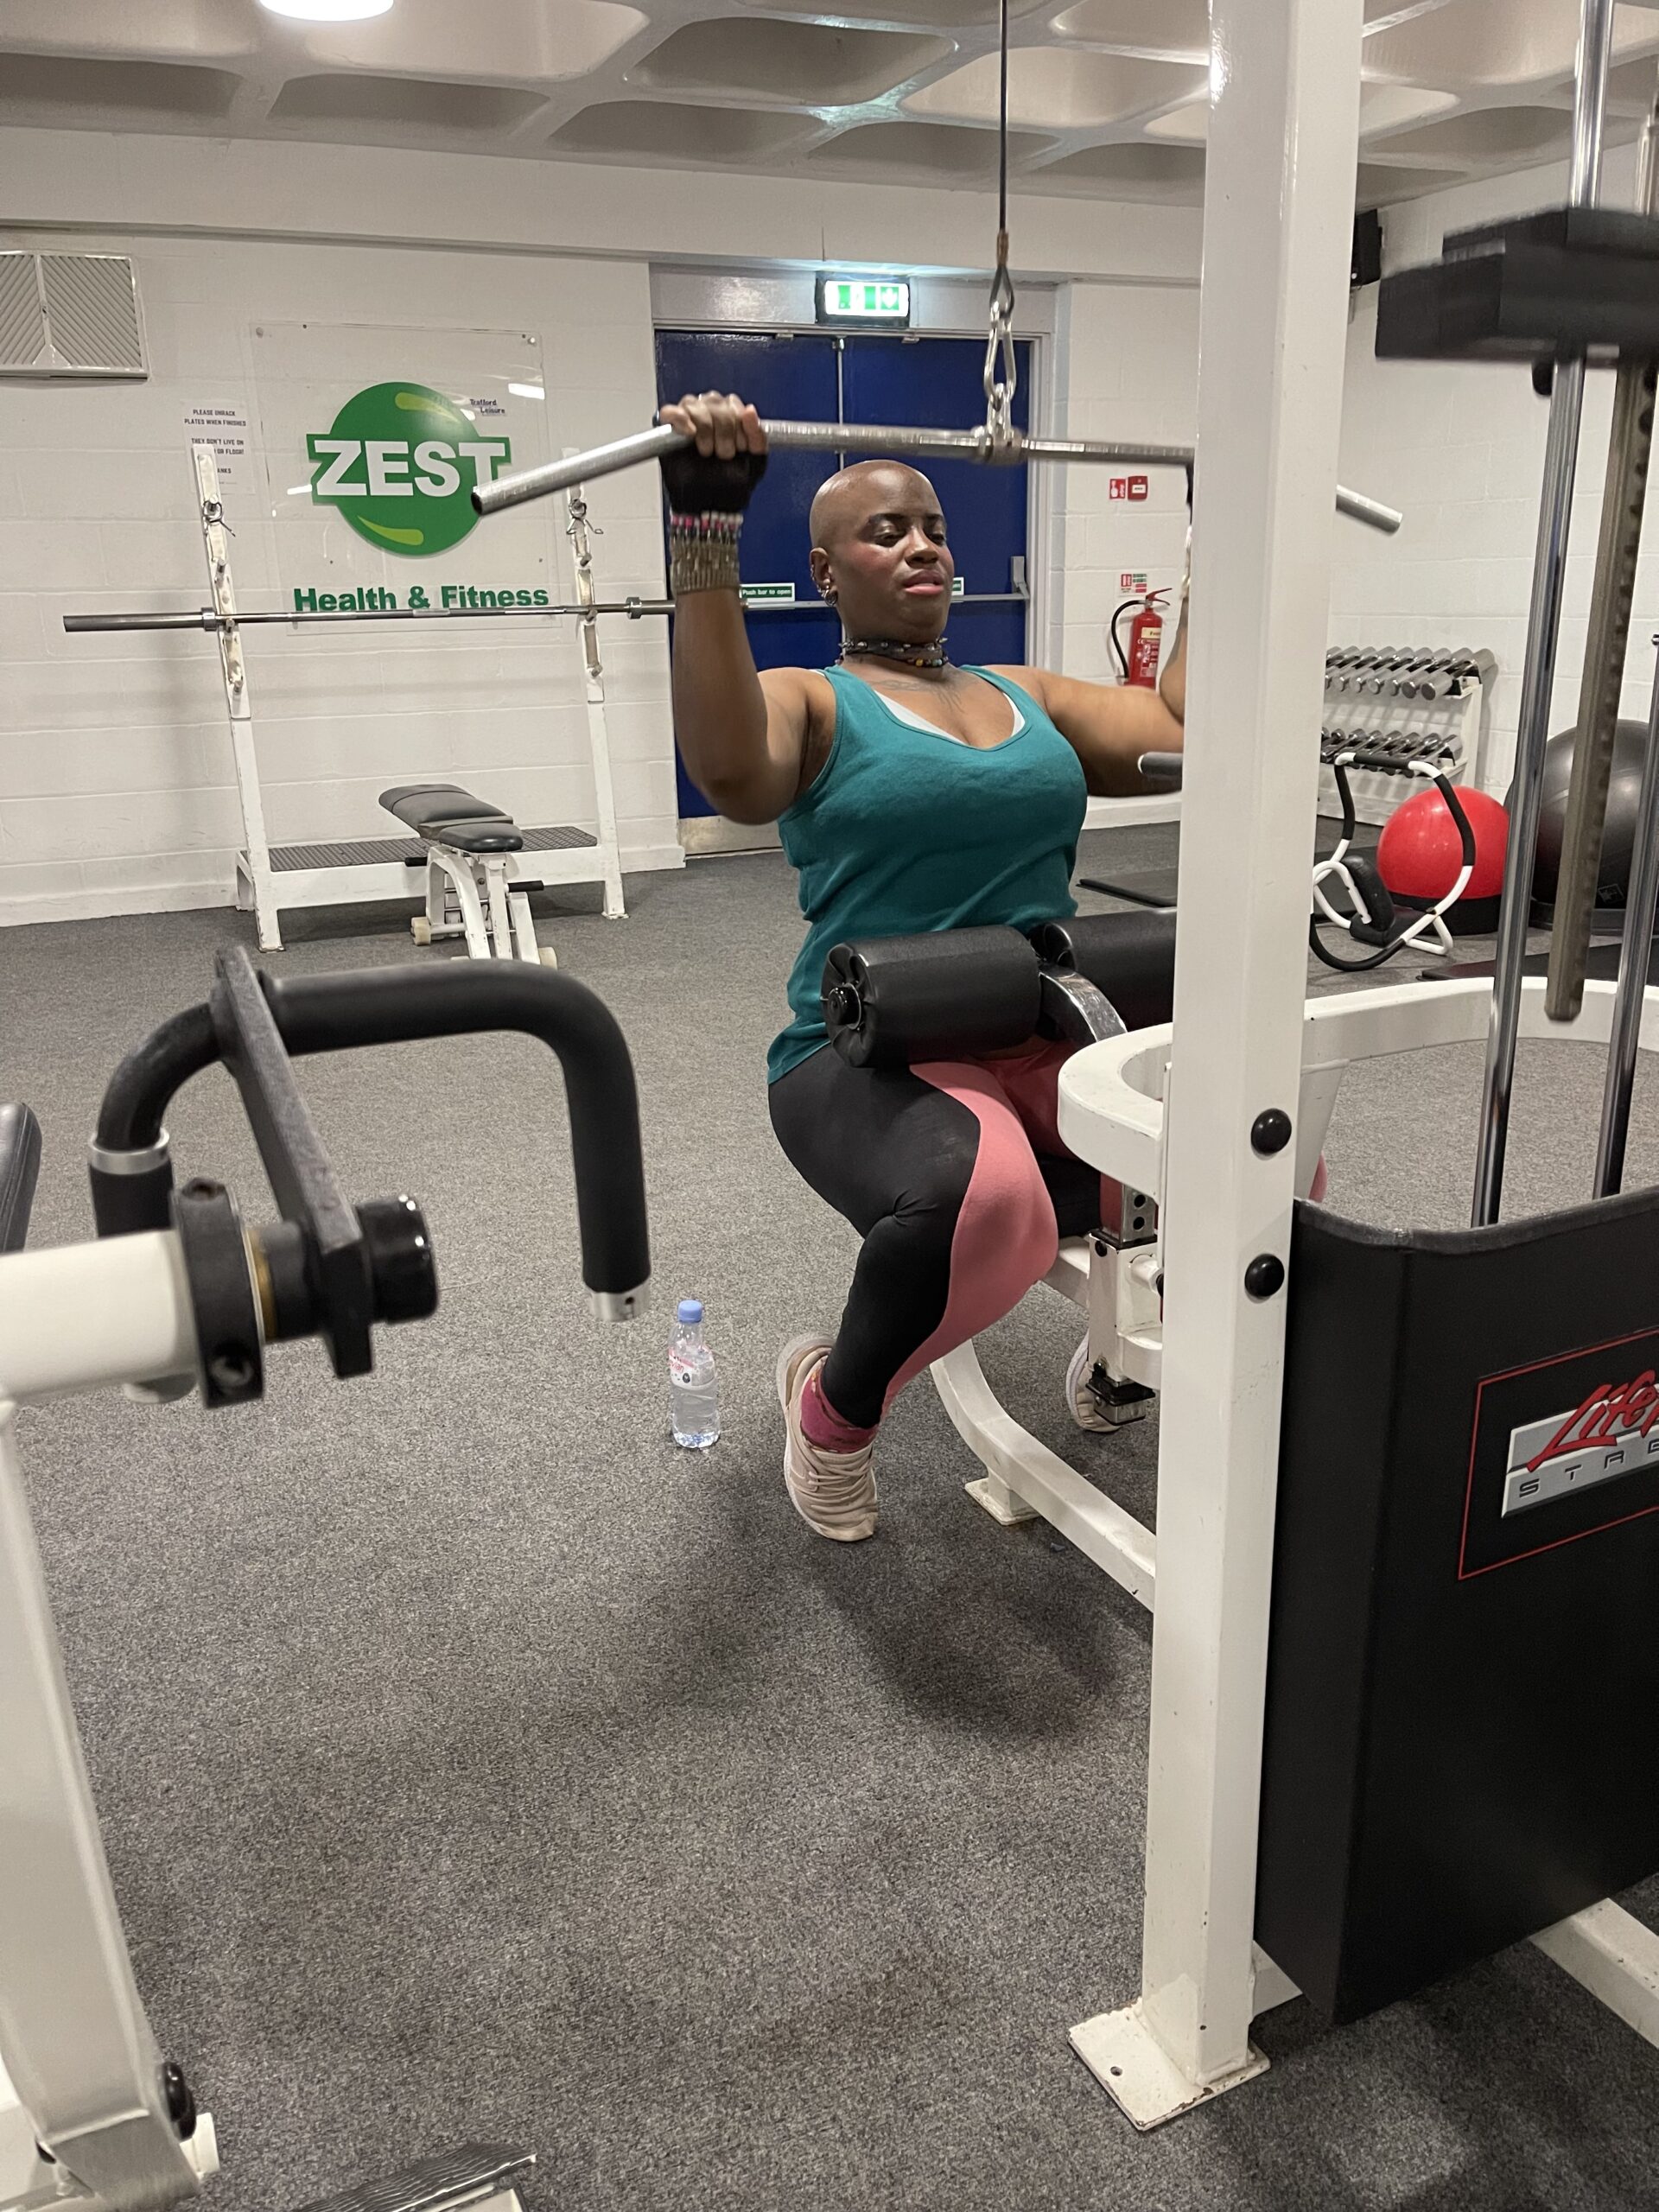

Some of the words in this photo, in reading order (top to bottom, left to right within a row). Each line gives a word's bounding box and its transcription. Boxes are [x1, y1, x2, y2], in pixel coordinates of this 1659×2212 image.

[314, 439, 506, 498] ZEST
[294, 587, 397, 612] Health
[408, 586, 430, 609] &
[441, 585, 550, 609] Fitness
[1526, 1369, 1656, 1473] Life
